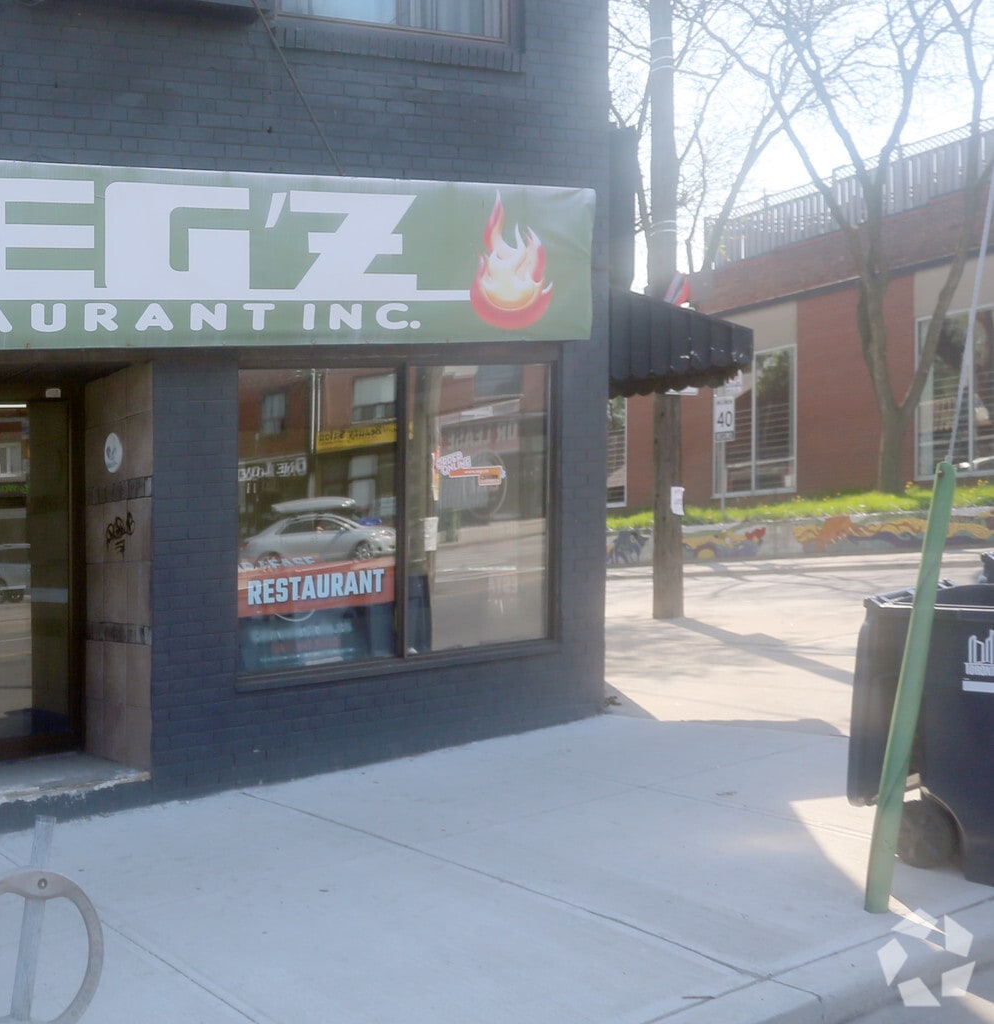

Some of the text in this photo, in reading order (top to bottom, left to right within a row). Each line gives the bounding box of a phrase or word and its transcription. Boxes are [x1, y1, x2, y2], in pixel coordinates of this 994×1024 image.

[303, 303, 422, 330] INC.
[717, 411, 733, 428] 40
[247, 567, 385, 606] RESTAURANT
